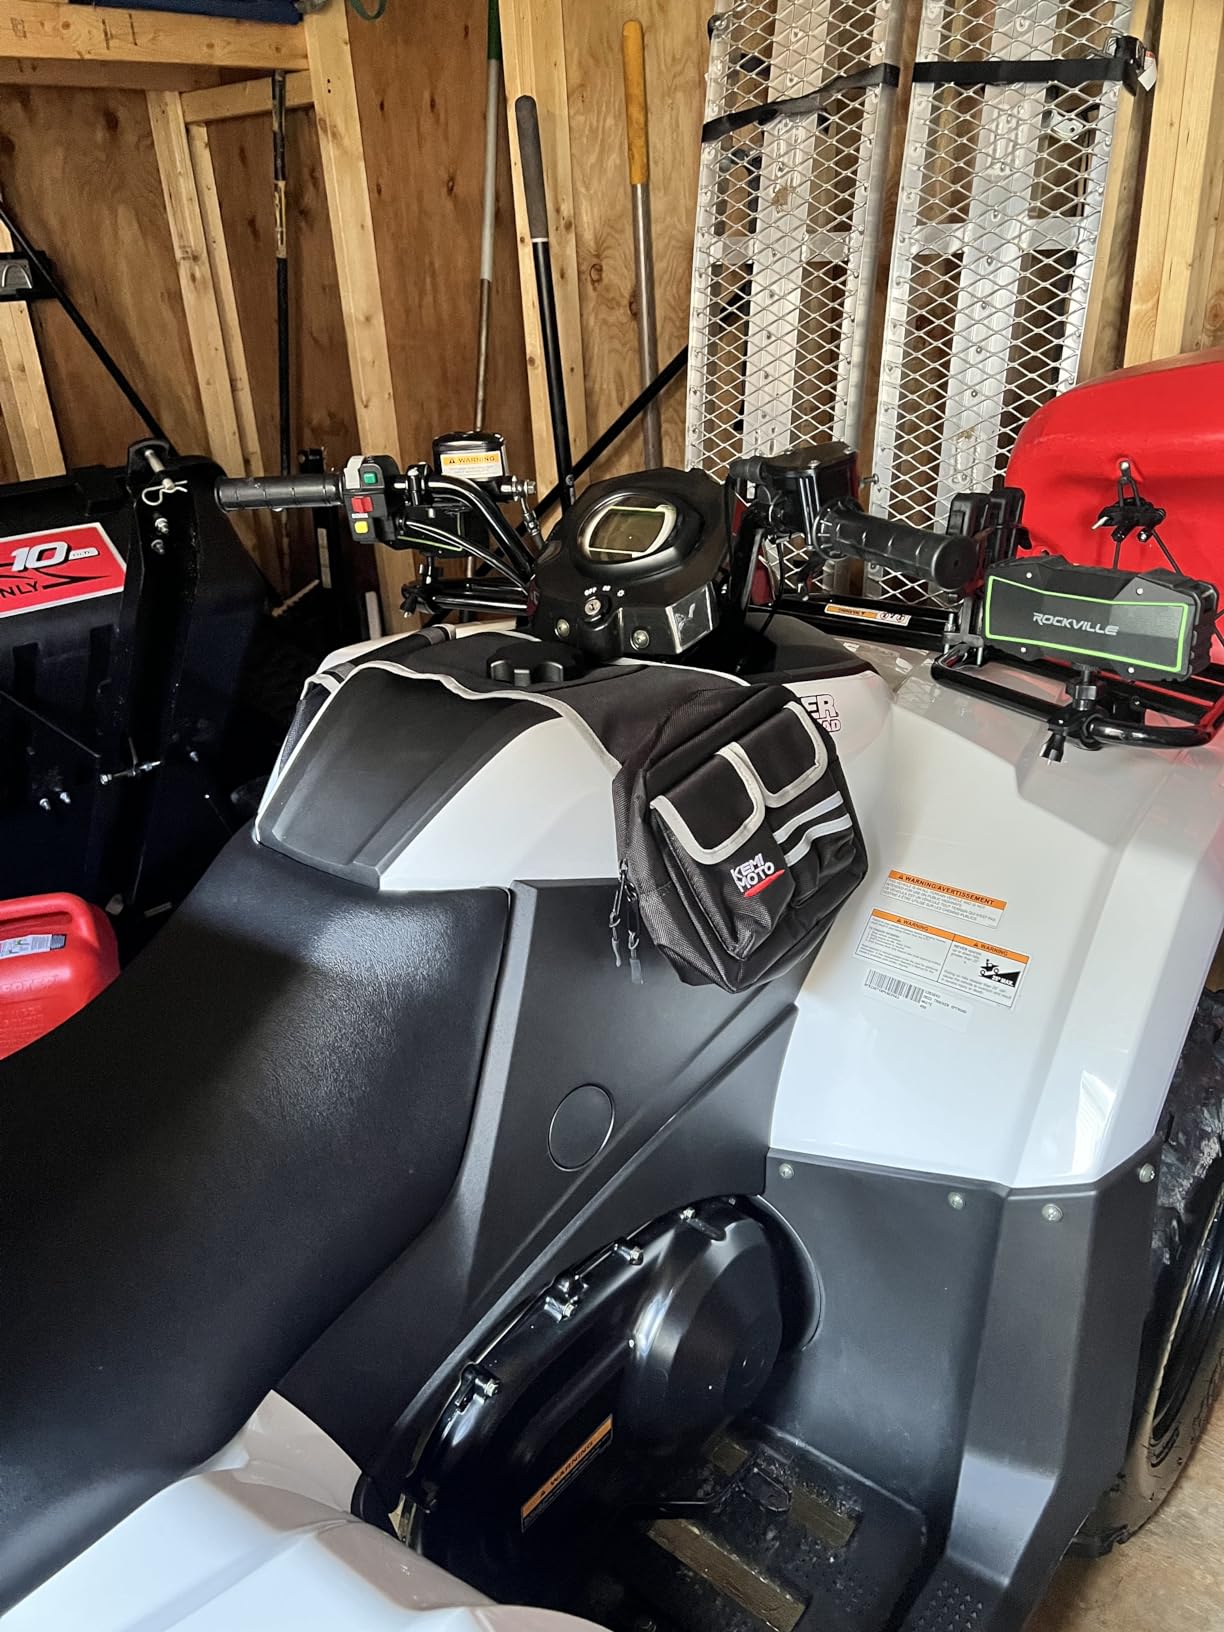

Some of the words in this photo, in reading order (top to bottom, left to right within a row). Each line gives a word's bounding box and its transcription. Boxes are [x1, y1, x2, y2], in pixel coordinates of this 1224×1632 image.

[458, 455, 495, 463] WARNING
[11, 541, 69, 572] 10
[1032, 611, 1119, 636] ROCKVILLE
[730, 853, 765, 879] KEMI
[736, 862, 775, 892] MOTO
[903, 919, 929, 931] WARNING
[980, 943, 1009, 956] WARNING
[550, 1441, 593, 1486] WARNING
